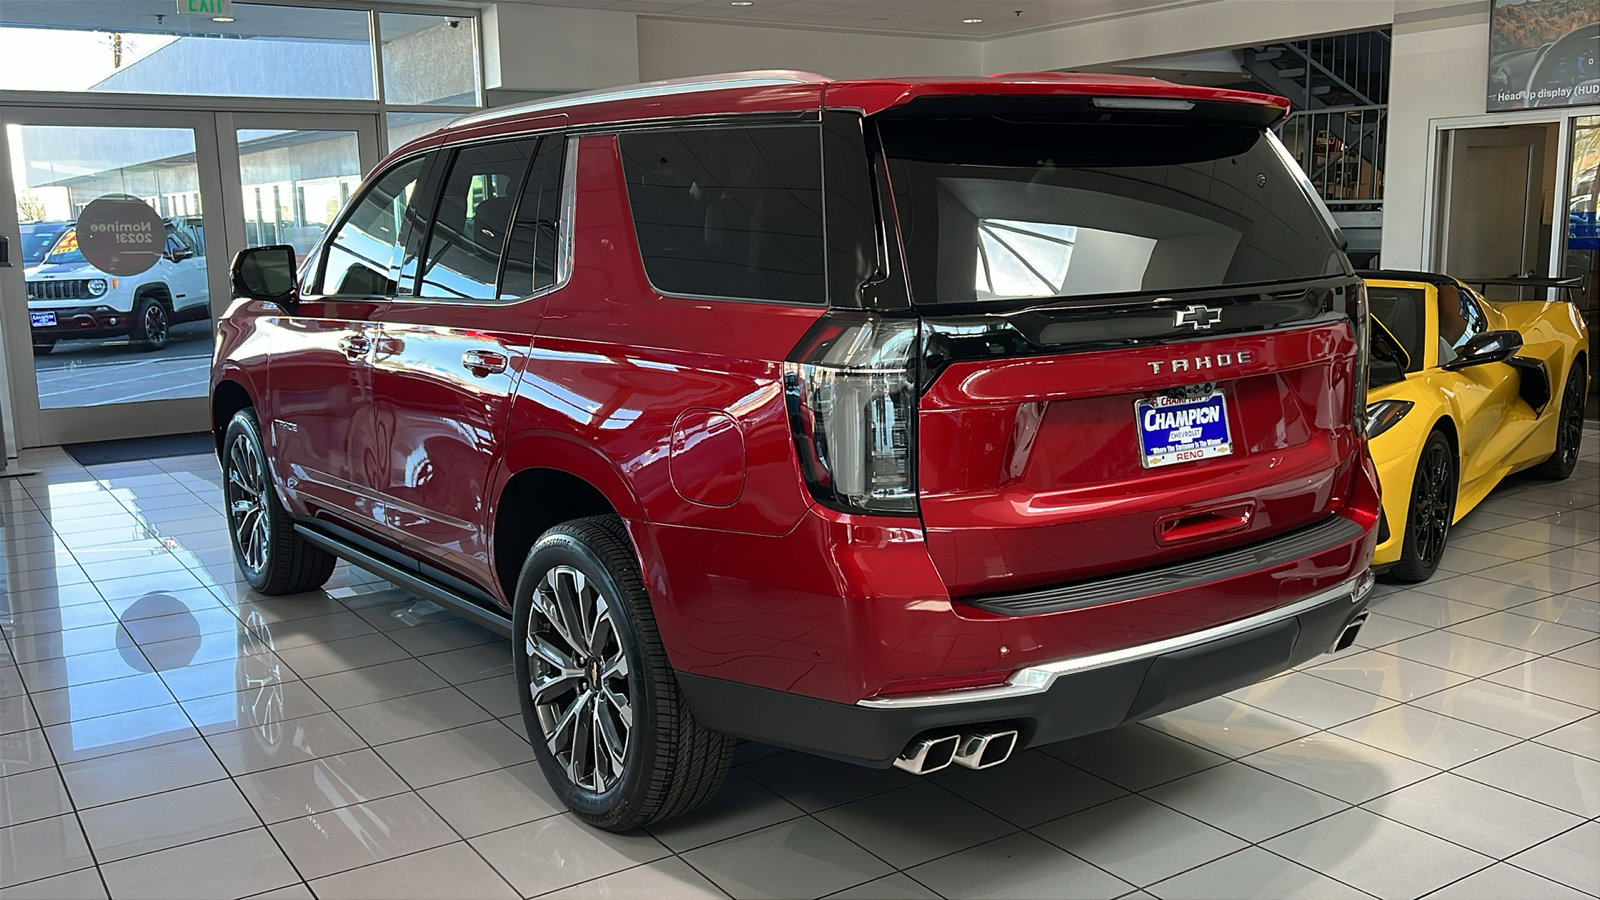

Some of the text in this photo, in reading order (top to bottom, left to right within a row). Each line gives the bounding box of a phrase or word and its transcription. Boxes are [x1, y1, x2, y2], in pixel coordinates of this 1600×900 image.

[1498, 91, 1521, 101] Head
[1537, 87, 1572, 99] display
[1147, 351, 1251, 374] TAHOE
[1144, 406, 1219, 431] CHAMPION
[1170, 429, 1200, 439] CHEVROLET
[1176, 449, 1204, 461] RENO
